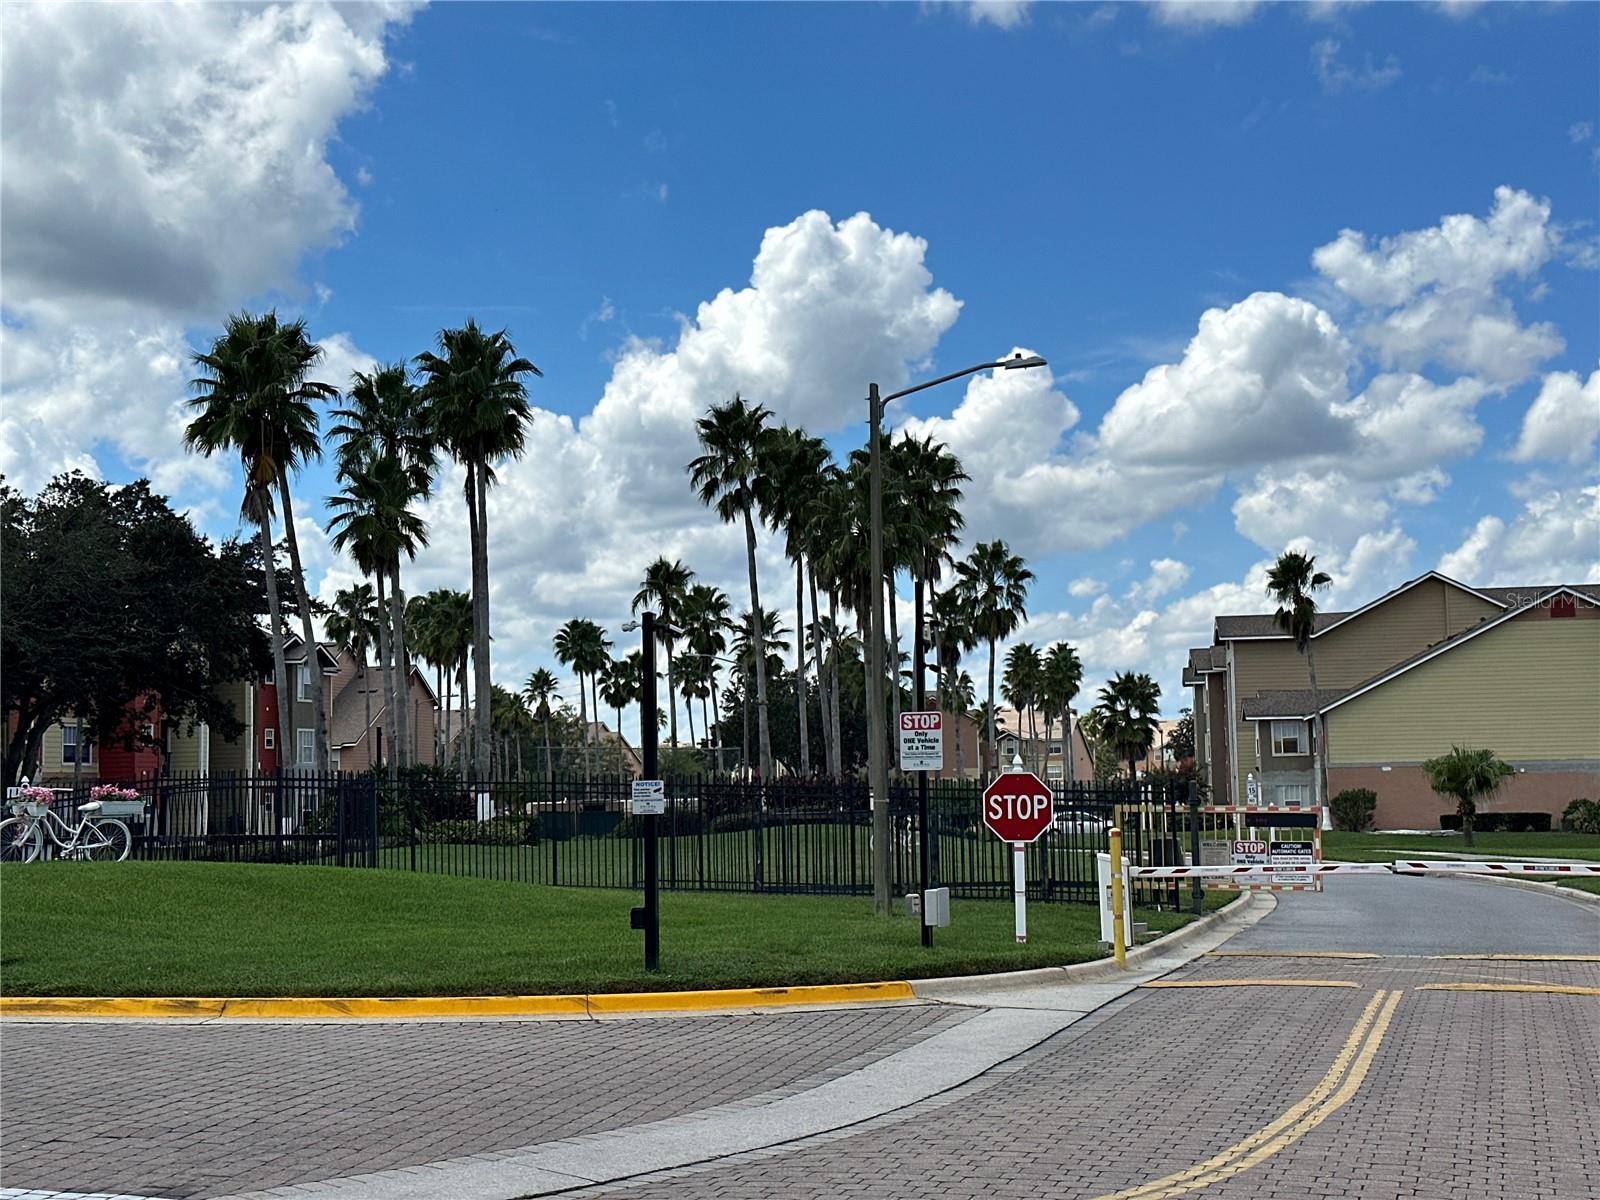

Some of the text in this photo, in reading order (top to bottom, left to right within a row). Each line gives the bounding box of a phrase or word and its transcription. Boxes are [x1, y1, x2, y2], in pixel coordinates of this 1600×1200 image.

[903, 714, 940, 729] STOP
[988, 794, 1048, 820] STOP
[1236, 842, 1265, 853] STOP
